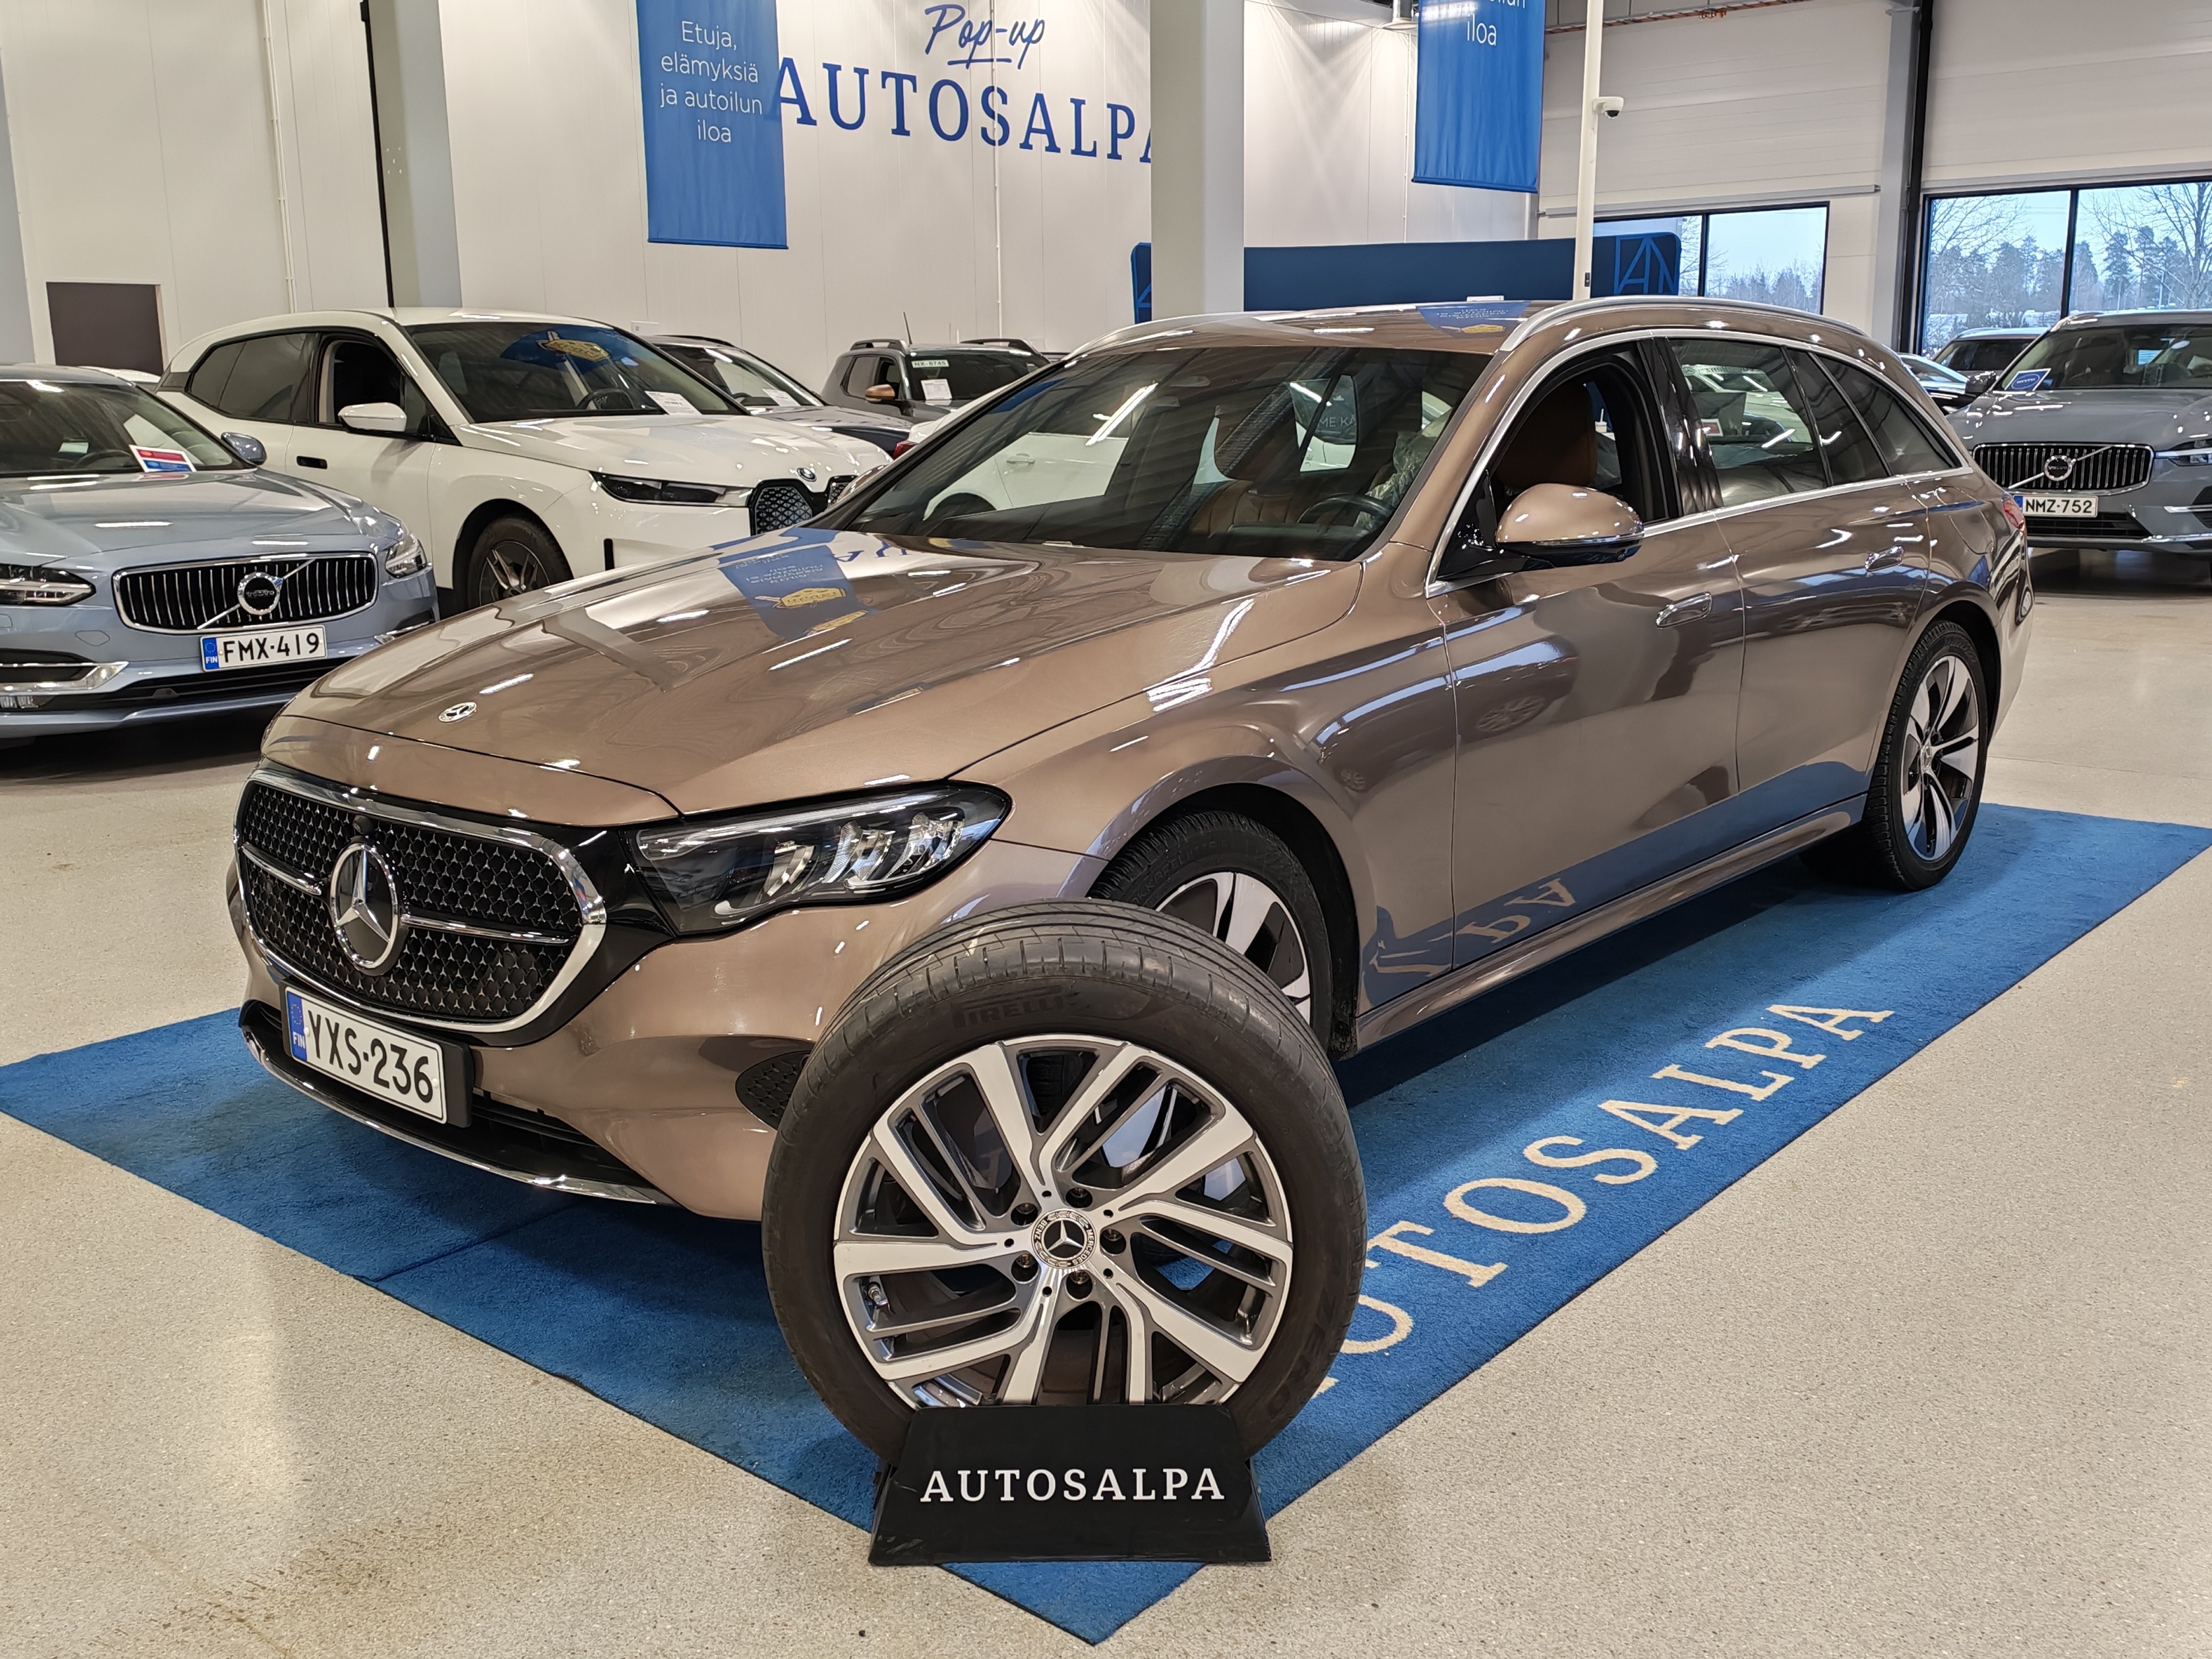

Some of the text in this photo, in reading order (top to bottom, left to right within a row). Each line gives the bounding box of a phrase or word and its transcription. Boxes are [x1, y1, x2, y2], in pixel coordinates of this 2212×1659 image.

[682, 21, 737, 50] Etuja,
[924, 4, 1046, 70] Pop-up
[1467, 12, 1497, 46] iloa
[661, 51, 758, 83] elämyksiä
[660, 83, 763, 115] ja autoilun
[697, 119, 731, 143] iloa
[2025, 498, 2092, 514] NMZ-752
[206, 656, 218, 664] FIN
[222, 632, 319, 663] FMX-419
[292, 1031, 306, 1049] FIN
[307, 1009, 434, 1103] YXS-236
[1313, 1003, 1895, 1399] UTOSALPA
[1034, 1219, 1048, 1240] BENZ
[1071, 1229, 1095, 1265] MERCEDES
[920, 1467, 1225, 1503] AUTOSALPA
